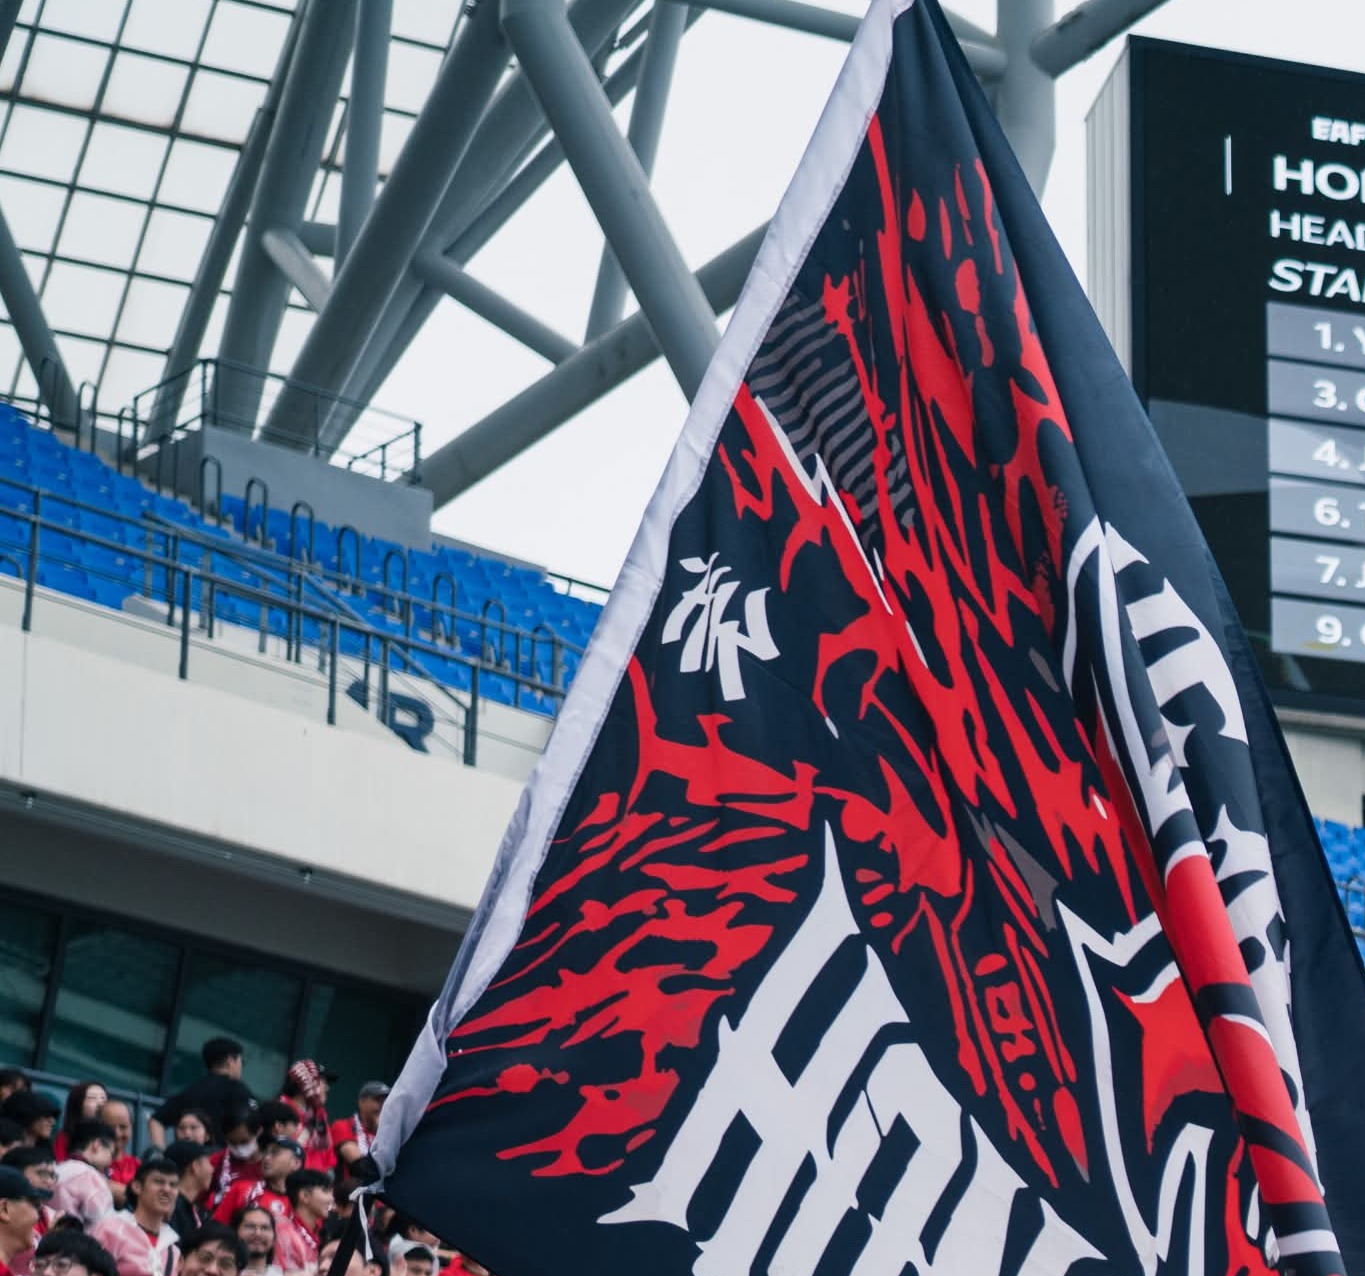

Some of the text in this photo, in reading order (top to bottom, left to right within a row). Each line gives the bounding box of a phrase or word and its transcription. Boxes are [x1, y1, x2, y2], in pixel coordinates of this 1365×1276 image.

[1314, 322, 1345, 352] 1.
[1312, 379, 1347, 412] 3.
[1312, 438, 1350, 469] 4.
[1313, 497, 1351, 529] 6.
[1315, 555, 1346, 587] 7.
[1315, 614, 1351, 647] 9.
